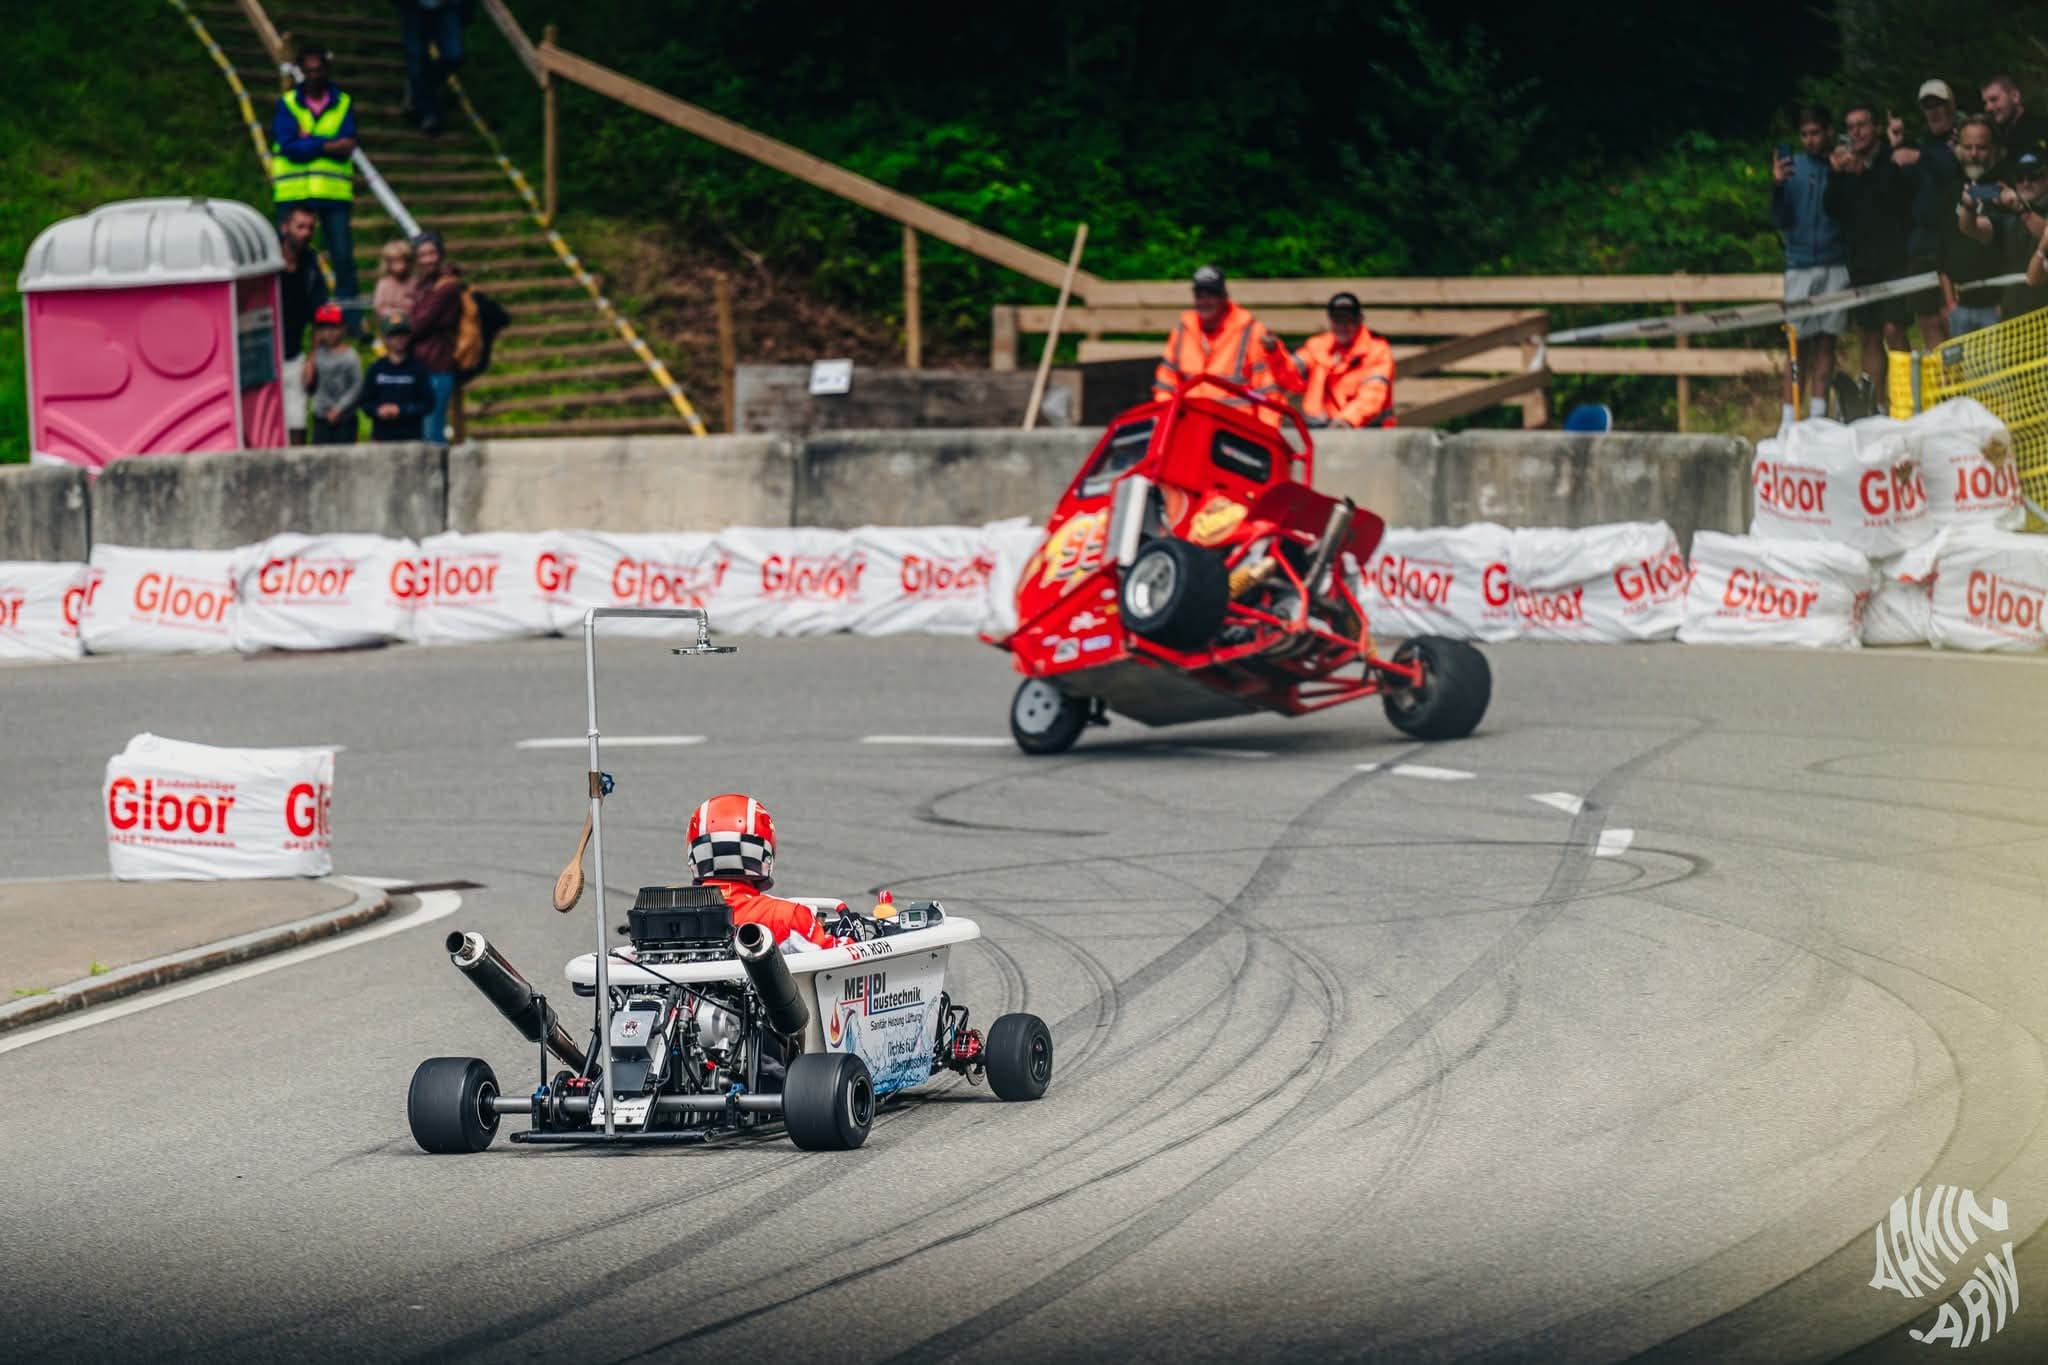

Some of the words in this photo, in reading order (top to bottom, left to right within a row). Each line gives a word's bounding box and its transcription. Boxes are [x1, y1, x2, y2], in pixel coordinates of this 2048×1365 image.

[1753, 461, 1827, 512] Gloor
[134, 572, 235, 623] Gloor
[258, 557, 356, 597] Gloor
[1374, 555, 1454, 604] Gloor
[1723, 566, 1818, 619] Gloor
[109, 776, 236, 834] Gloor
